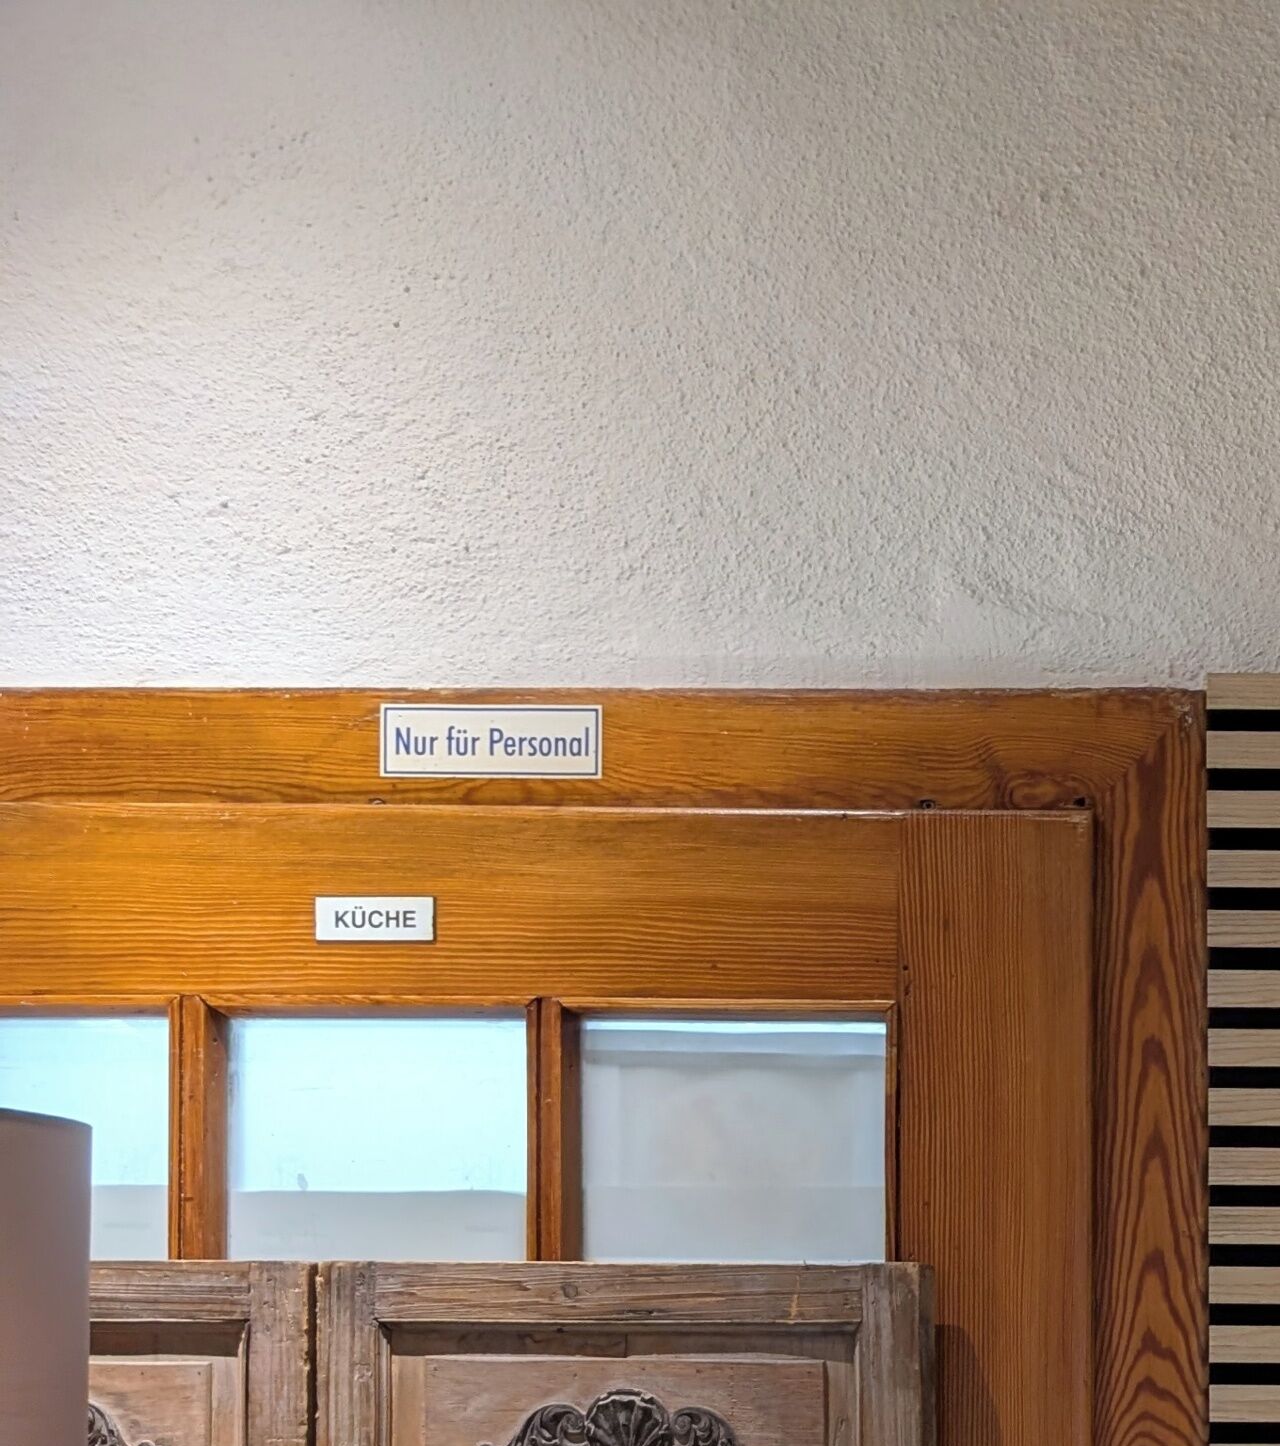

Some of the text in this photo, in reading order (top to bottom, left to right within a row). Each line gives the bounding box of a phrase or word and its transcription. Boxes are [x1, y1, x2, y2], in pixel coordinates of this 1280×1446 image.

[395, 725, 590, 757] Nur für Personal
[334, 906, 417, 929] KÜCHE
